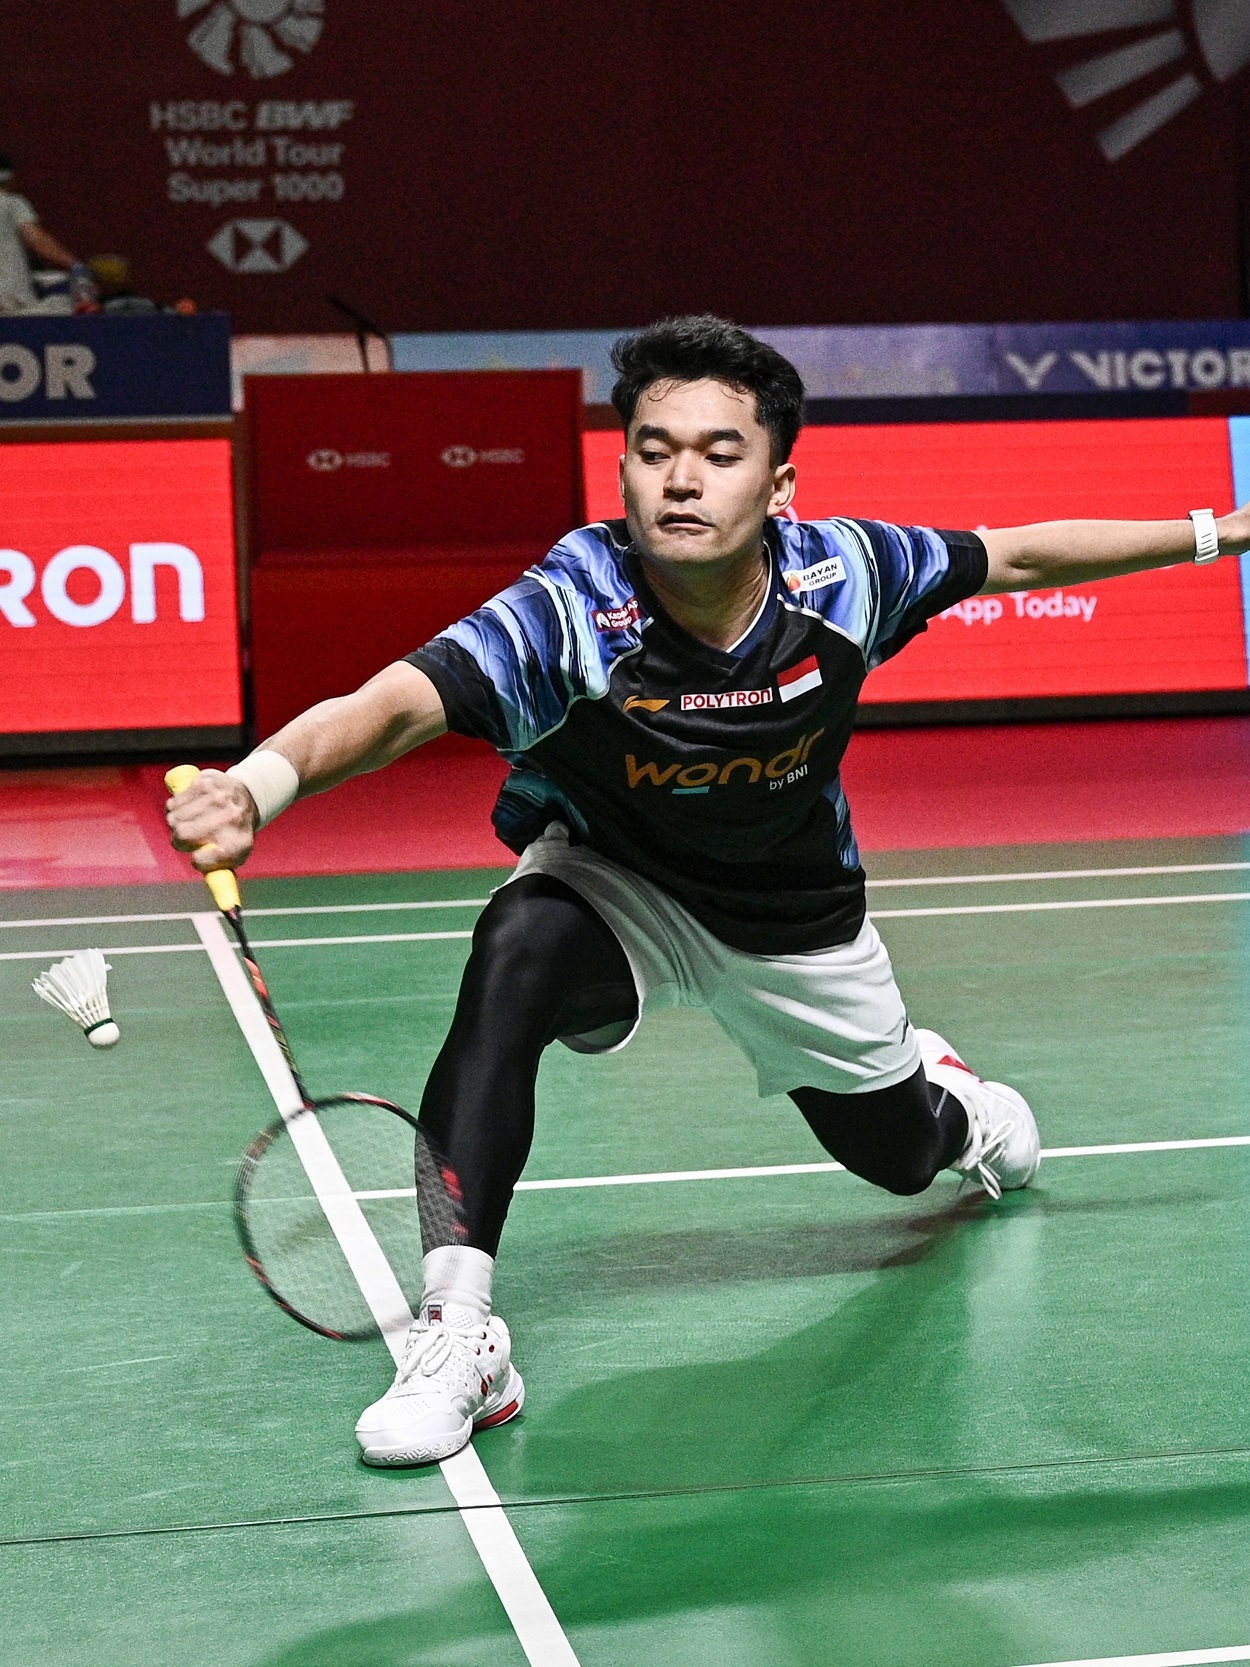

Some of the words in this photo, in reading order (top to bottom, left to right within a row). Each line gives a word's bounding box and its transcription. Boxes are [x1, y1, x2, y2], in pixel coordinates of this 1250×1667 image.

[150, 101, 248, 130] HSBC
[165, 136, 266, 166] World
[271, 136, 344, 166] Tour
[168, 173, 263, 208] Super
[272, 173, 344, 201] 1000
[803, 563, 838, 581] BAYAN
[809, 572, 837, 586] GROUP
[1008, 590, 1098, 622] Today
[611, 616, 632, 628] Group
[683, 689, 772, 709] POLYTRON
[625, 727, 825, 789] wondr
[769, 777, 785, 791] by
[786, 764, 809, 784] BNI
